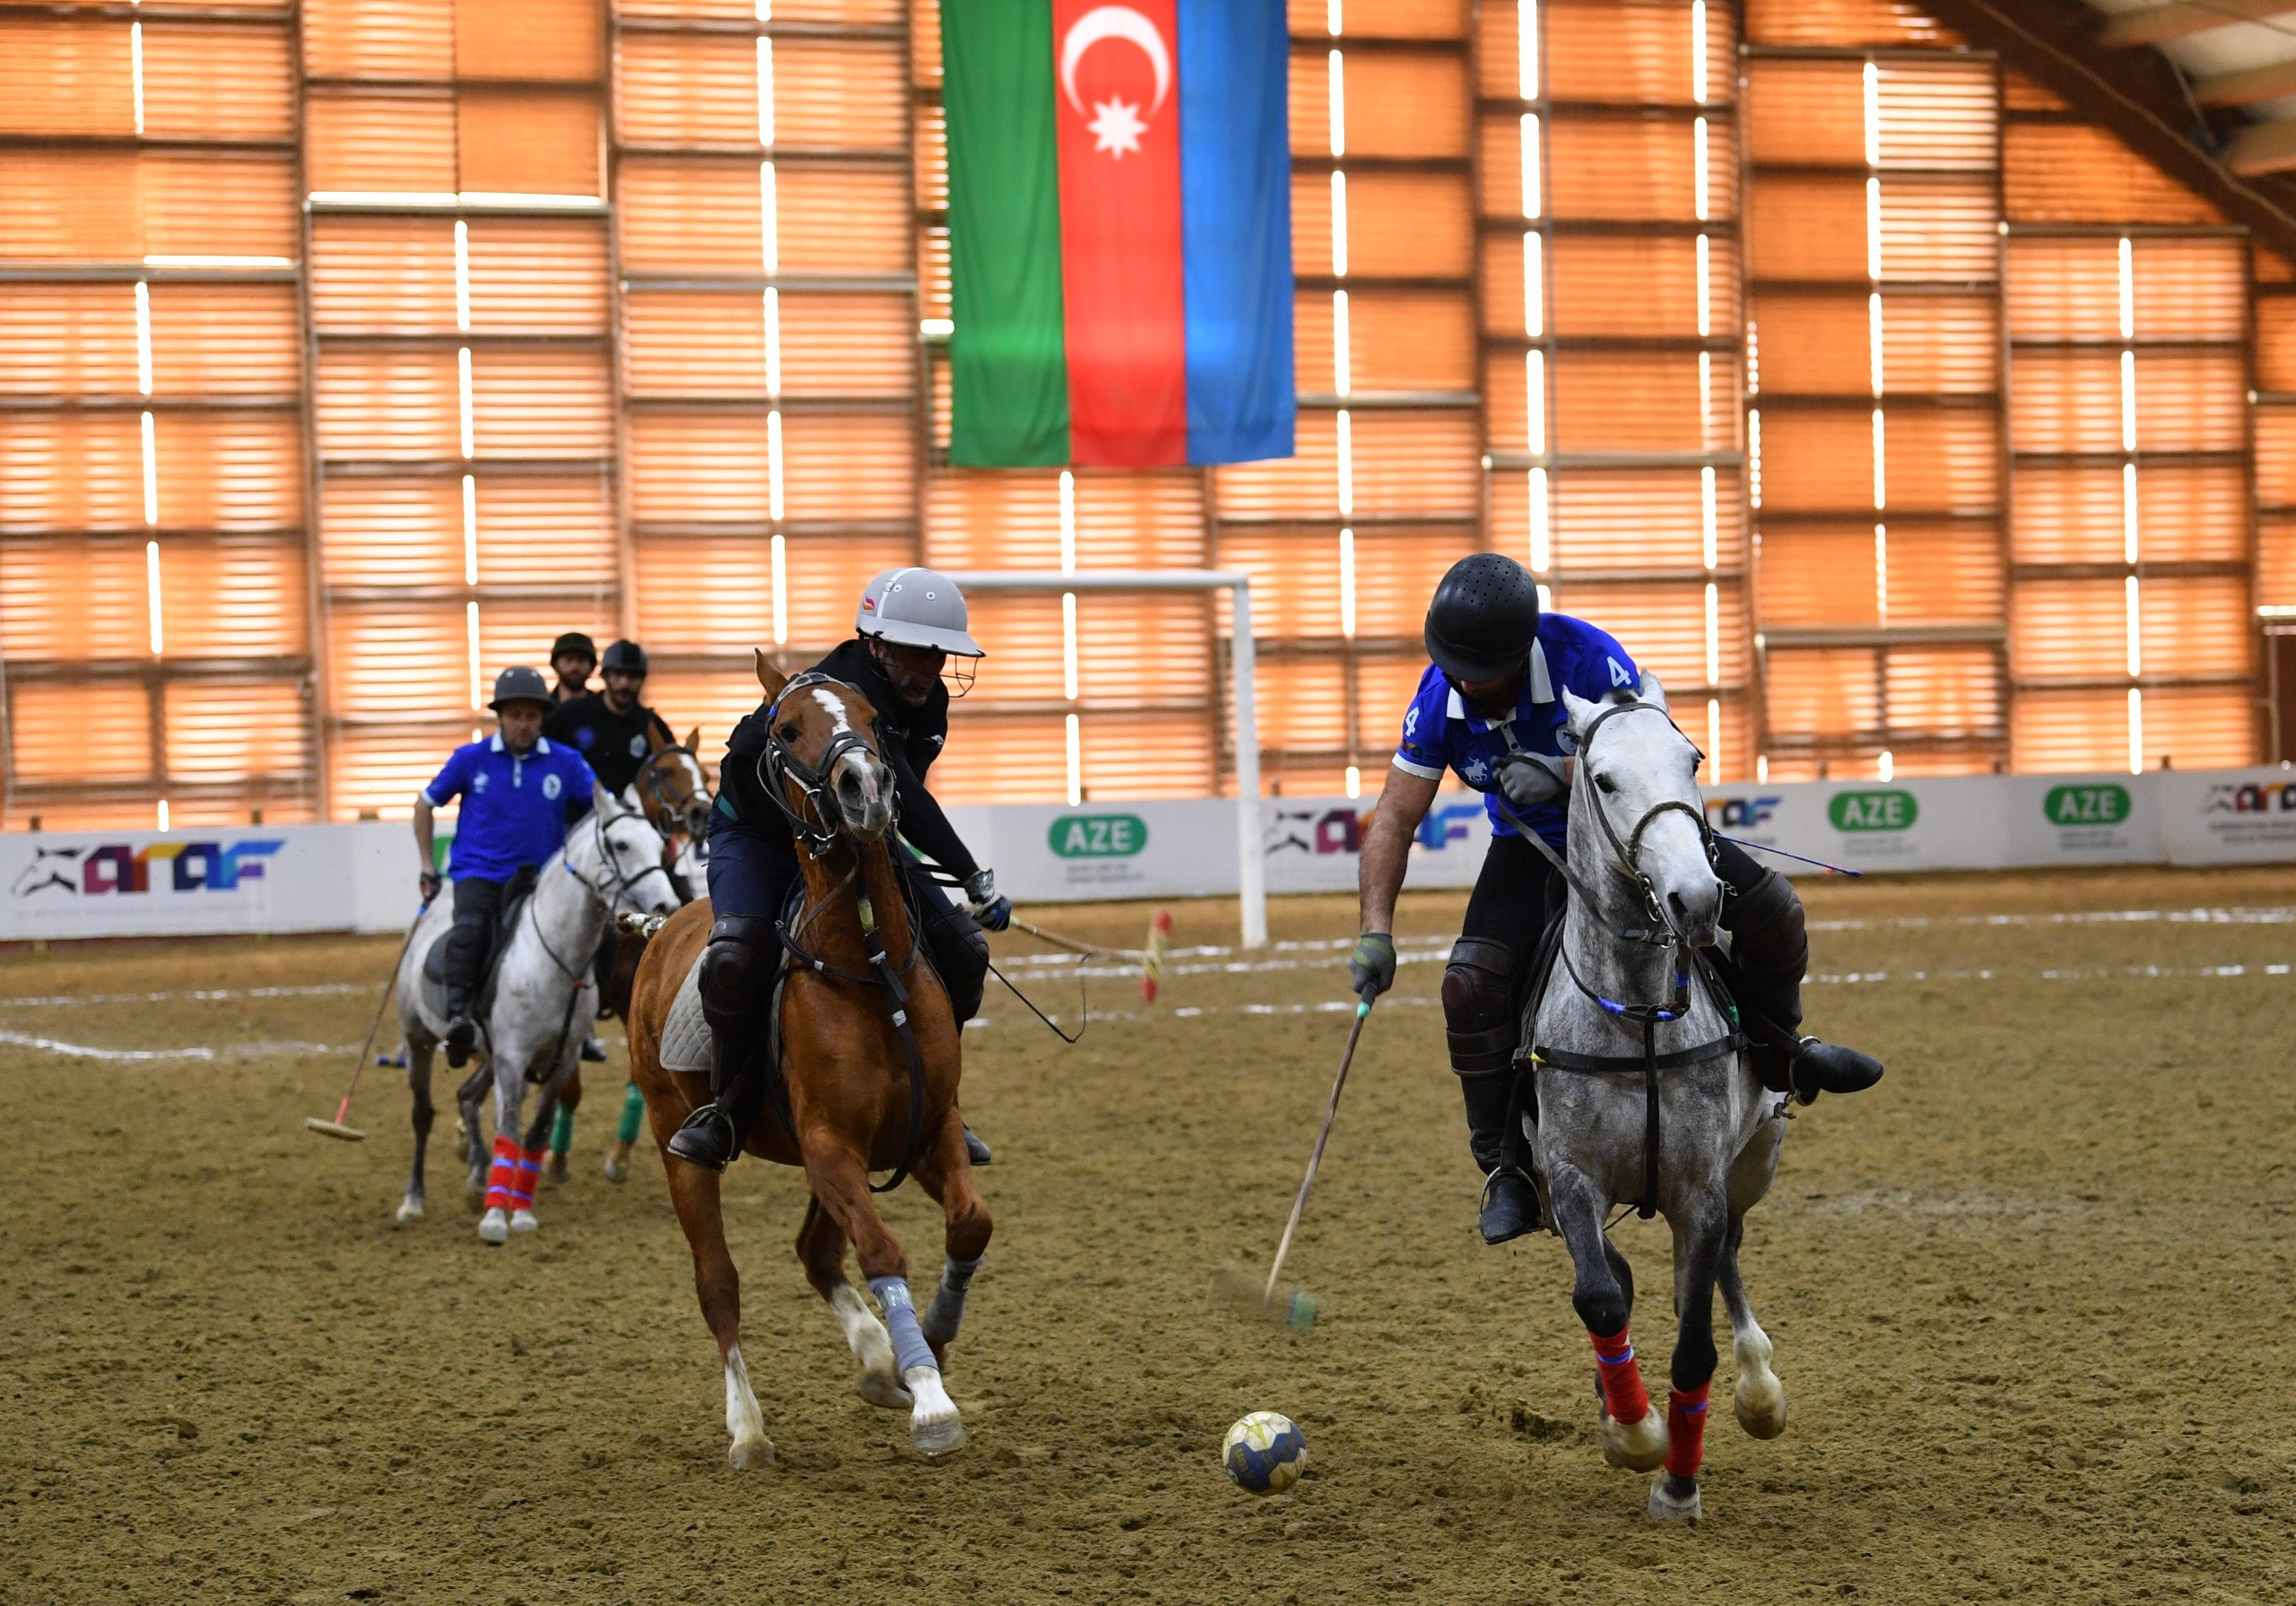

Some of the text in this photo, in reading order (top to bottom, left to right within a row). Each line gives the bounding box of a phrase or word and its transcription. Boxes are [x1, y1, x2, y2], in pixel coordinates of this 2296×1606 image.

[1607, 656, 1631, 687] 4
[1405, 707, 1419, 737] 4
[1841, 795, 1903, 826] AZE
[2057, 789, 2118, 820] AZE
[1064, 820, 1133, 854] AZE
